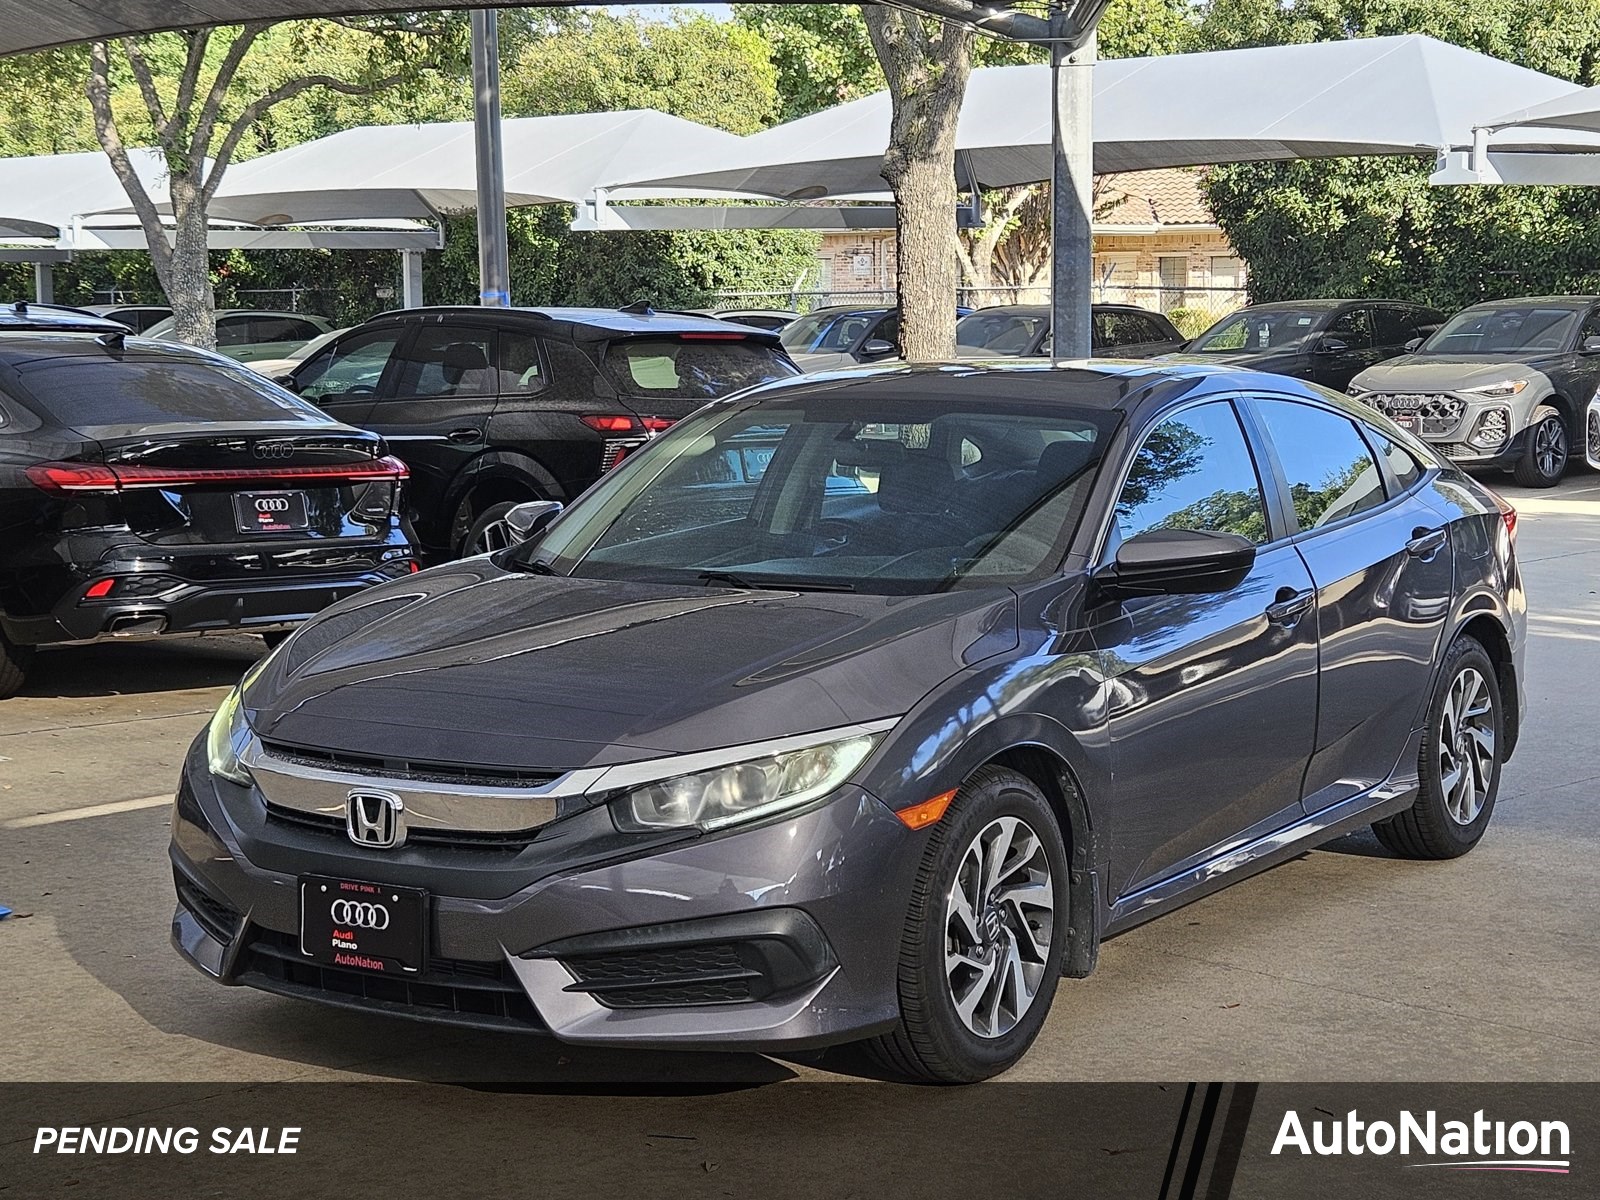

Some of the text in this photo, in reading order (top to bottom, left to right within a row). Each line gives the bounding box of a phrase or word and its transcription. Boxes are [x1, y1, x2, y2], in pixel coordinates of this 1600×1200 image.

[340, 882, 359, 892] DRIVE
[360, 885, 375, 894] PINK
[332, 929, 354, 940] Audi
[332, 938, 358, 950] Plano
[334, 953, 384, 971] AutoNation
